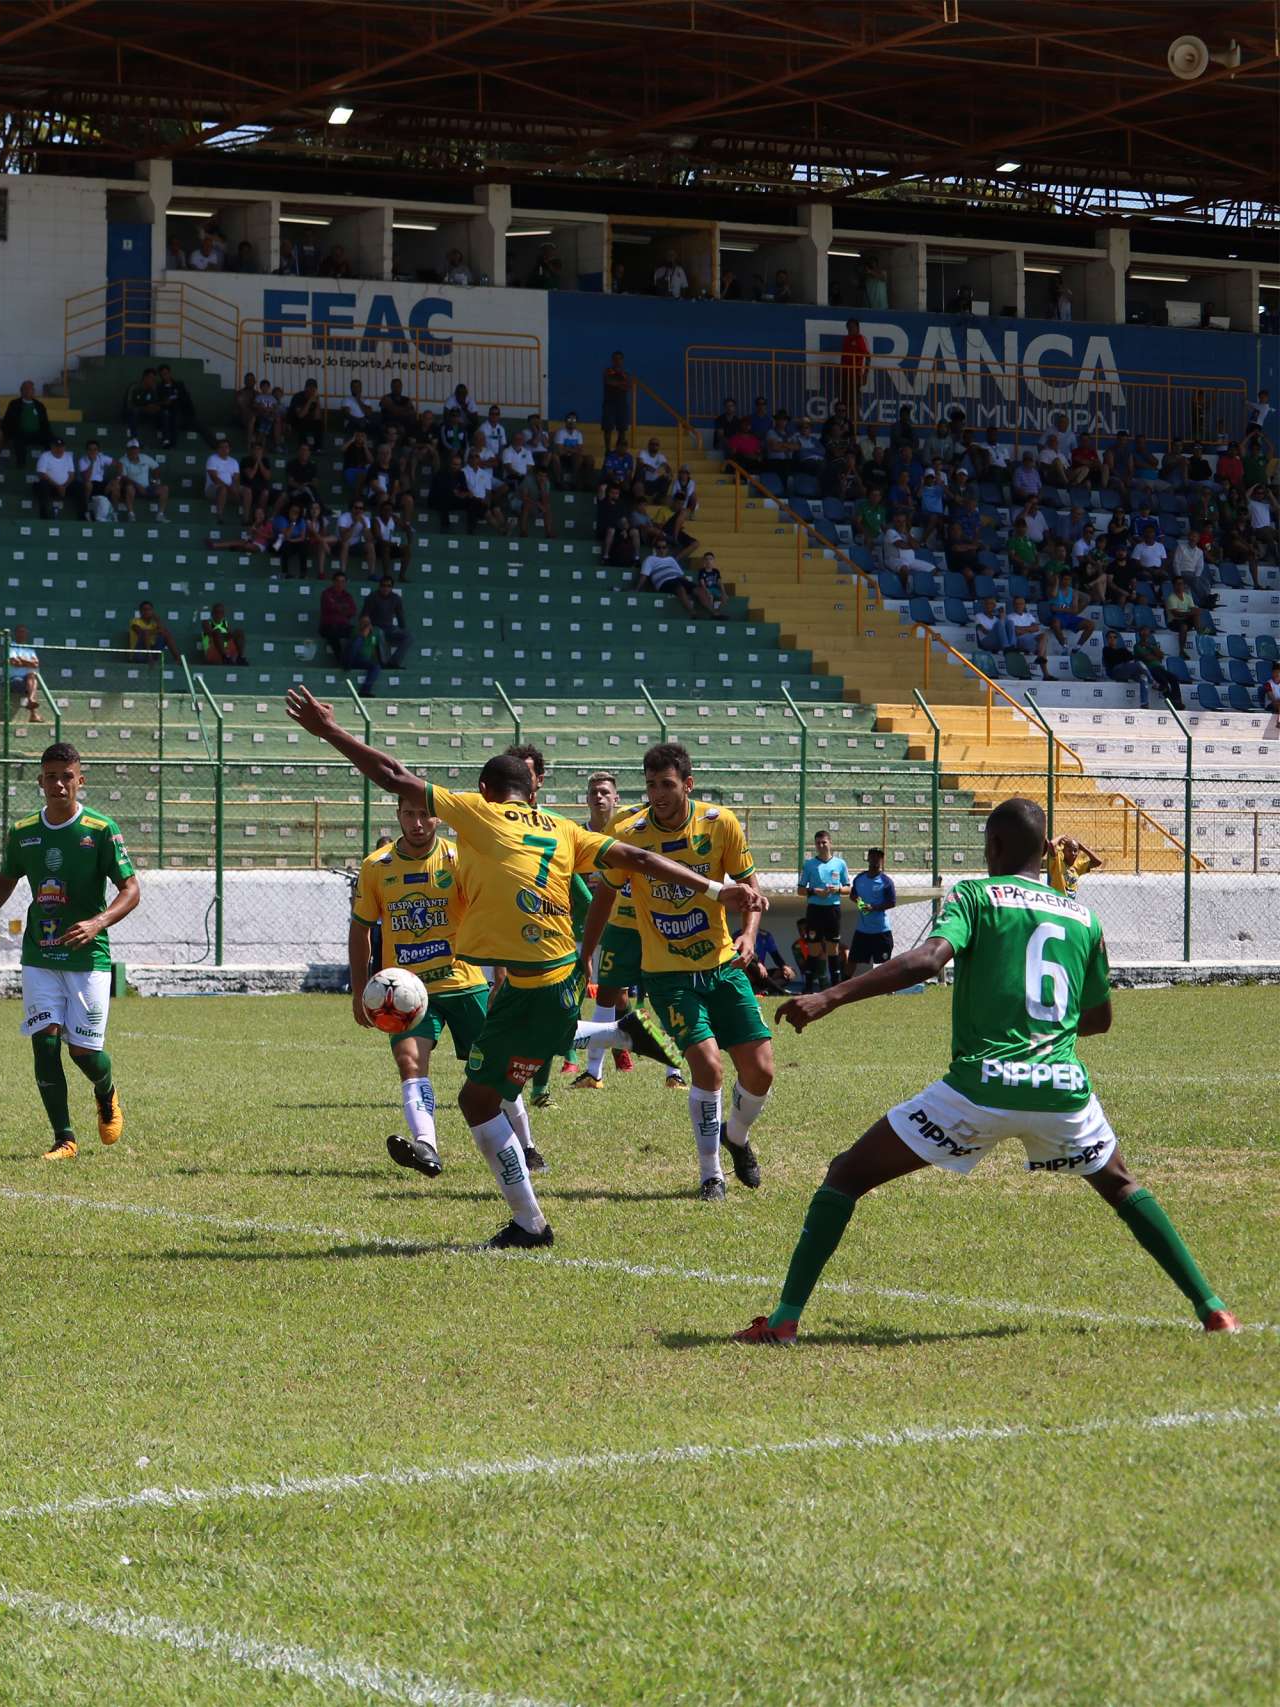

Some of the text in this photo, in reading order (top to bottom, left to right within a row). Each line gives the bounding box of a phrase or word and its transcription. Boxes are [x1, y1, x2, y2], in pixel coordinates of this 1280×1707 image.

[263, 288, 454, 357] FEAC
[804, 318, 1127, 406] FRANCA
[522, 833, 558, 889] 7
[1003, 886, 1087, 917] PACAEMBU
[391, 911, 449, 932] BRASIL
[654, 912, 704, 936] Ecoville
[599, 950, 615, 972] 15
[1025, 921, 1069, 1022] 6
[980, 1058, 1085, 1091] PIPPER
